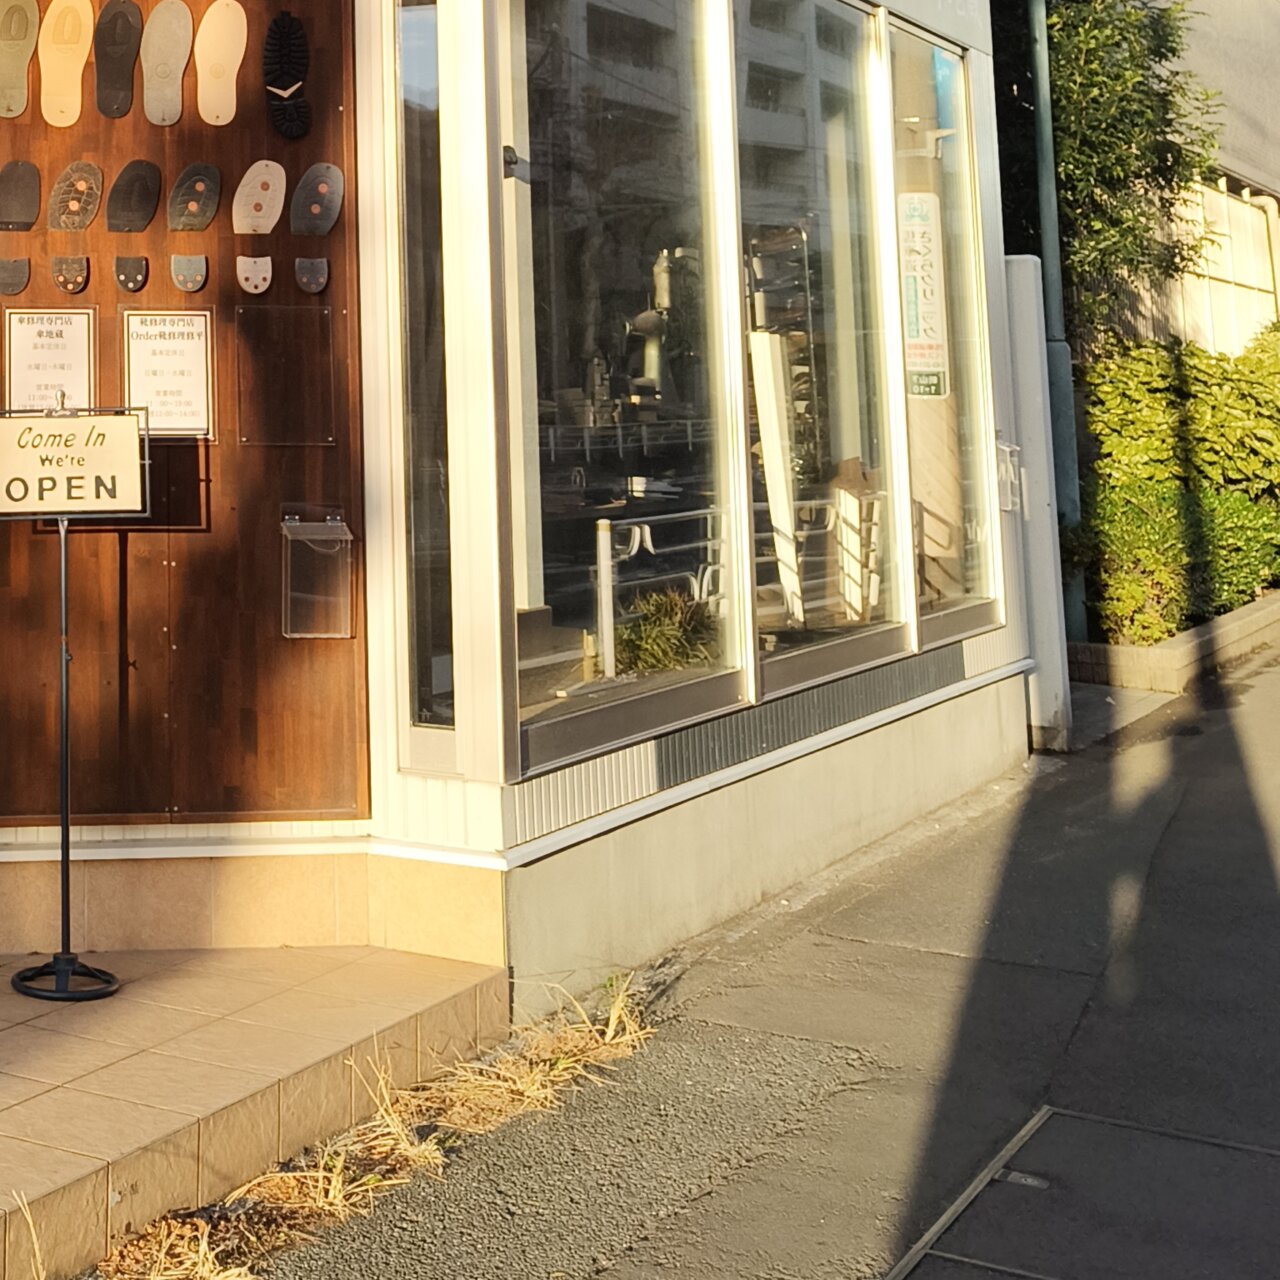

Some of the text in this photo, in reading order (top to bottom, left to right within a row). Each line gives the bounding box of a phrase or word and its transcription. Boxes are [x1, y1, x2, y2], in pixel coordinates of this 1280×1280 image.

[17, 425, 106, 449] Come In
[40, 454, 85, 467] We're
[5, 475, 117, 502] OPEN
